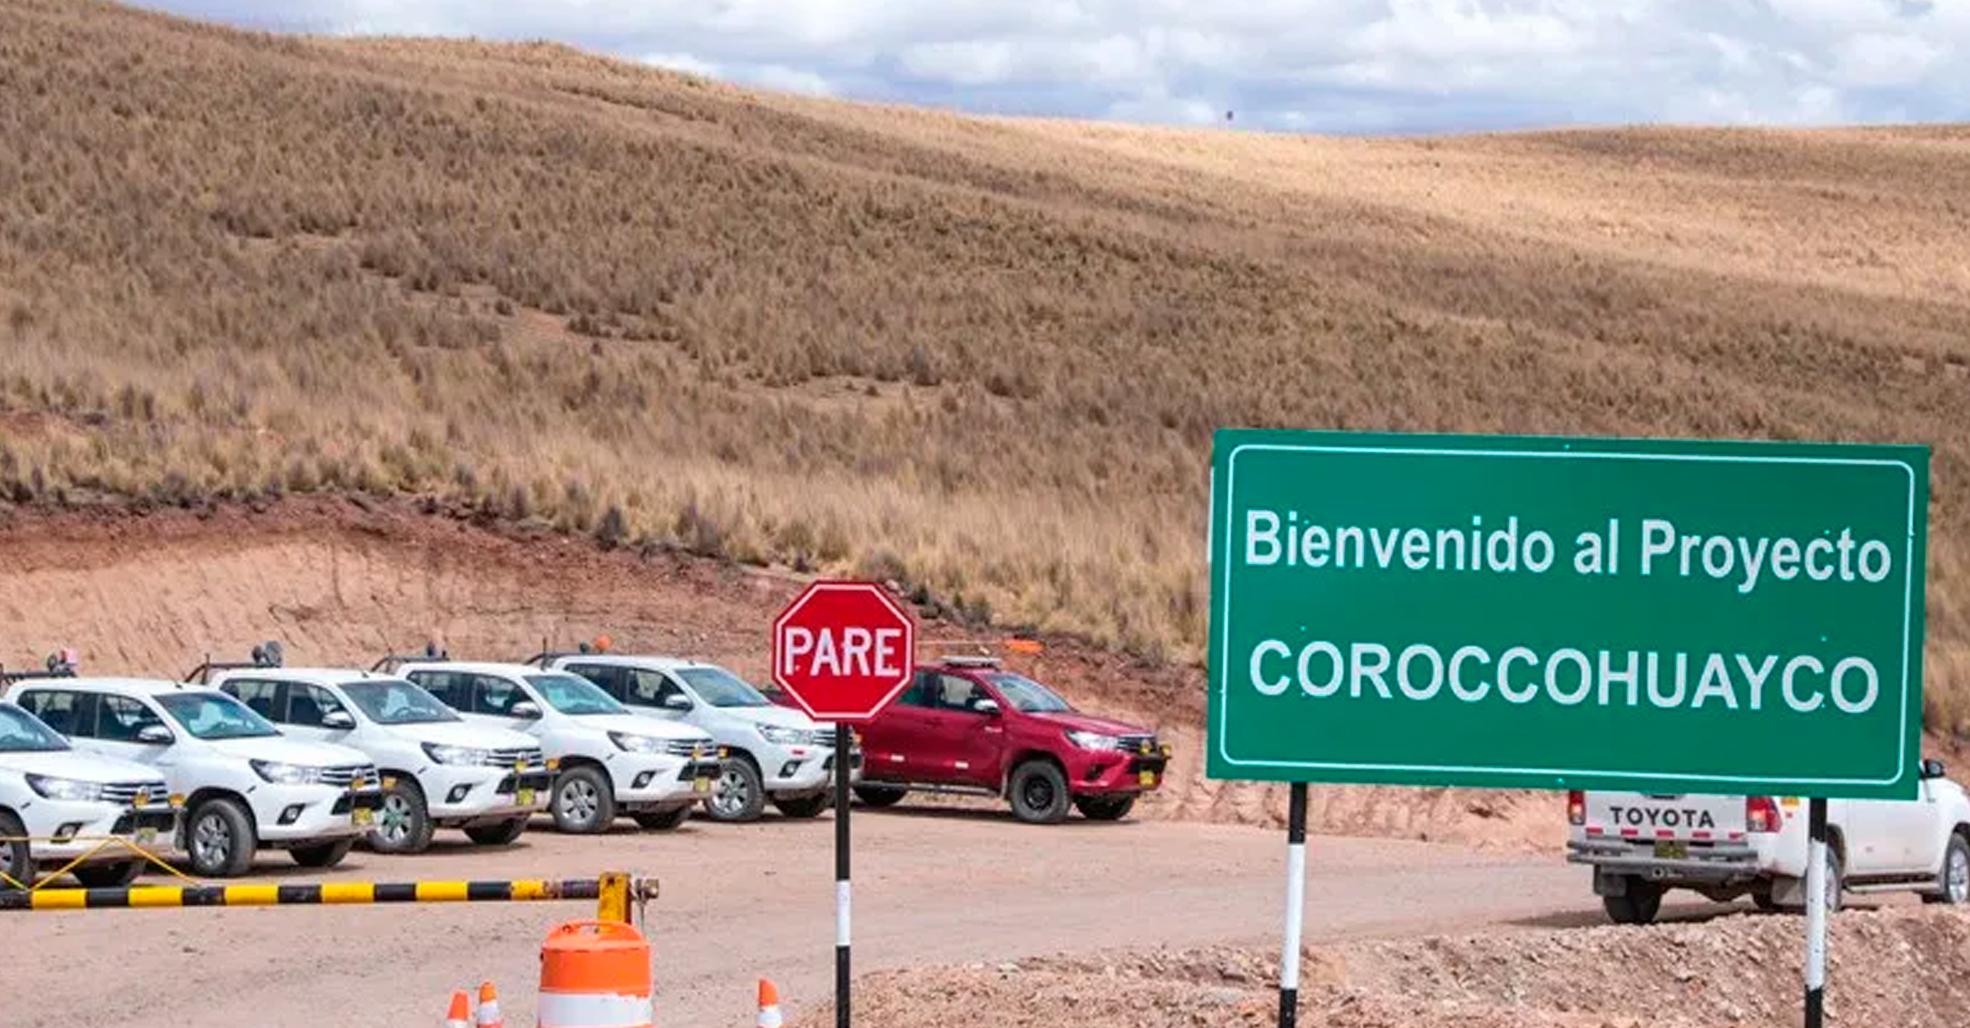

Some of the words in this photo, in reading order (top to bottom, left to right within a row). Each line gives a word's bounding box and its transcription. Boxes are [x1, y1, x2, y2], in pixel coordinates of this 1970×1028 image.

[1245, 509, 1554, 573] Bienvenido
[1573, 518, 1618, 575] al
[1641, 519, 1892, 593] Proyecto
[784, 626, 902, 677] PARE
[1249, 639, 1879, 714] COROCCOHUAYCO
[1609, 806, 1715, 828] TOYOTA
